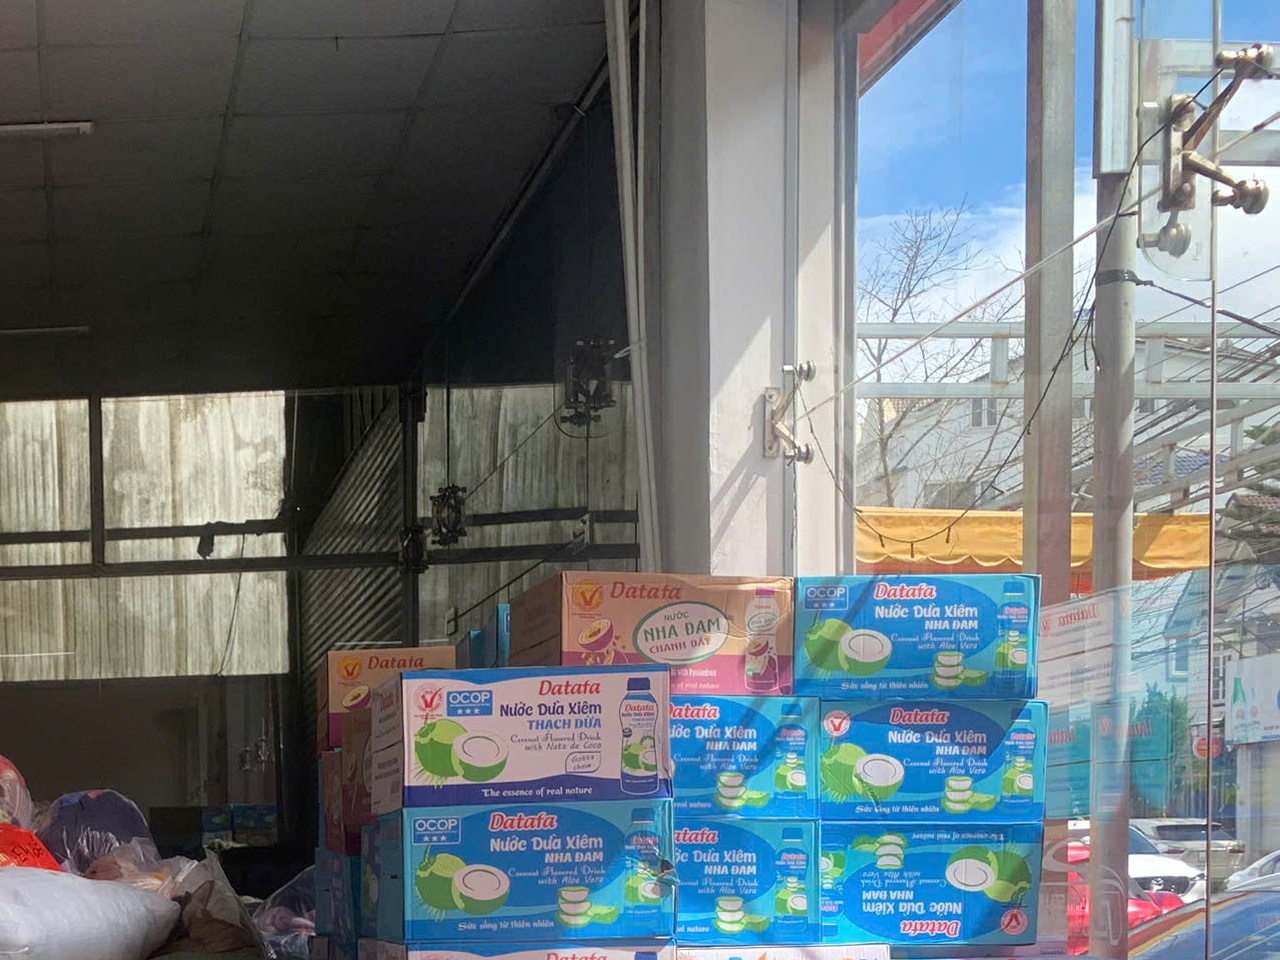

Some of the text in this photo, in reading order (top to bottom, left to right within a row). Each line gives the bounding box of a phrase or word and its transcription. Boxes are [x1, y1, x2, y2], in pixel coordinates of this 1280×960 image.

[611, 582, 682, 599] Datafa
[807, 588, 844, 598] OCOP
[873, 583, 937, 599] Datafa
[875, 604, 908, 618] Nước
[944, 605, 978, 617] Xiêm
[925, 620, 978, 630] NHA ĐAM
[643, 626, 679, 643] NHA
[650, 640, 686, 654] CHANH
[367, 655, 424, 670] Datafa
[539, 680, 601, 695] Datafa
[450, 692, 490, 703] OCOP
[500, 699, 601, 717] Nước Dừa Xiêm
[890, 708, 949, 724] Datafa
[888, 729, 920, 743] Nước
[955, 730, 986, 742] Xiêm
[706, 742, 729, 750] NHA
[936, 746, 959, 755] NHA
[482, 788, 500, 797] The
[533, 787, 544, 797] of
[547, 787, 562, 795] real
[415, 820, 457, 830] OCOP
[489, 813, 557, 831] Datafa
[490, 834, 602, 851] Nước Dừa Xiêm
[545, 852, 603, 863] NHA ĐAM
[723, 850, 756, 862] Xiêm
[704, 866, 756, 874] NHA ĐAM
[862, 890, 913, 899] NHA ĐAM
[862, 902, 961, 916] Nước Dừa Xiêm
[901, 921, 960, 937] Datafa
